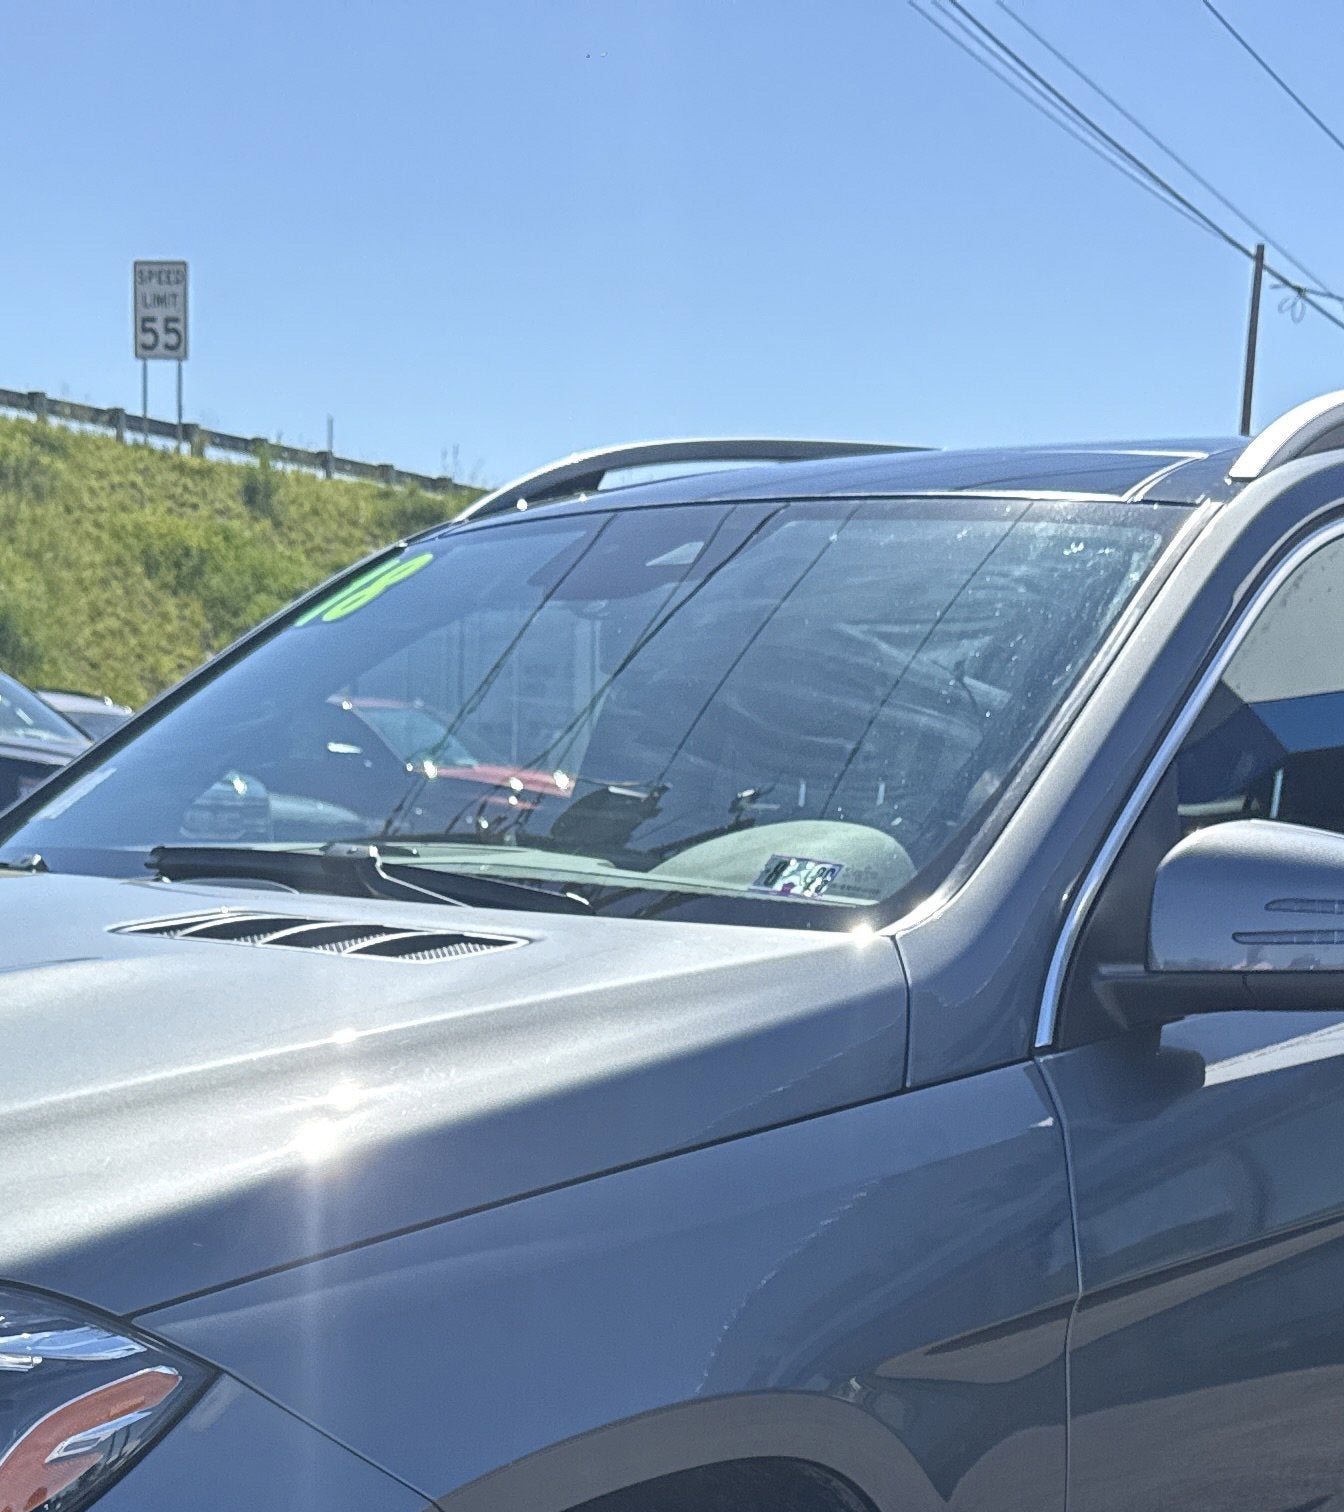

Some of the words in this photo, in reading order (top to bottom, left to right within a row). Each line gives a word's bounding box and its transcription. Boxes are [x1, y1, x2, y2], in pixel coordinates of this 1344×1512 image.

[138, 269, 183, 285] SPEED
[141, 292, 177, 309] LIMIT
[140, 316, 182, 351] 55
